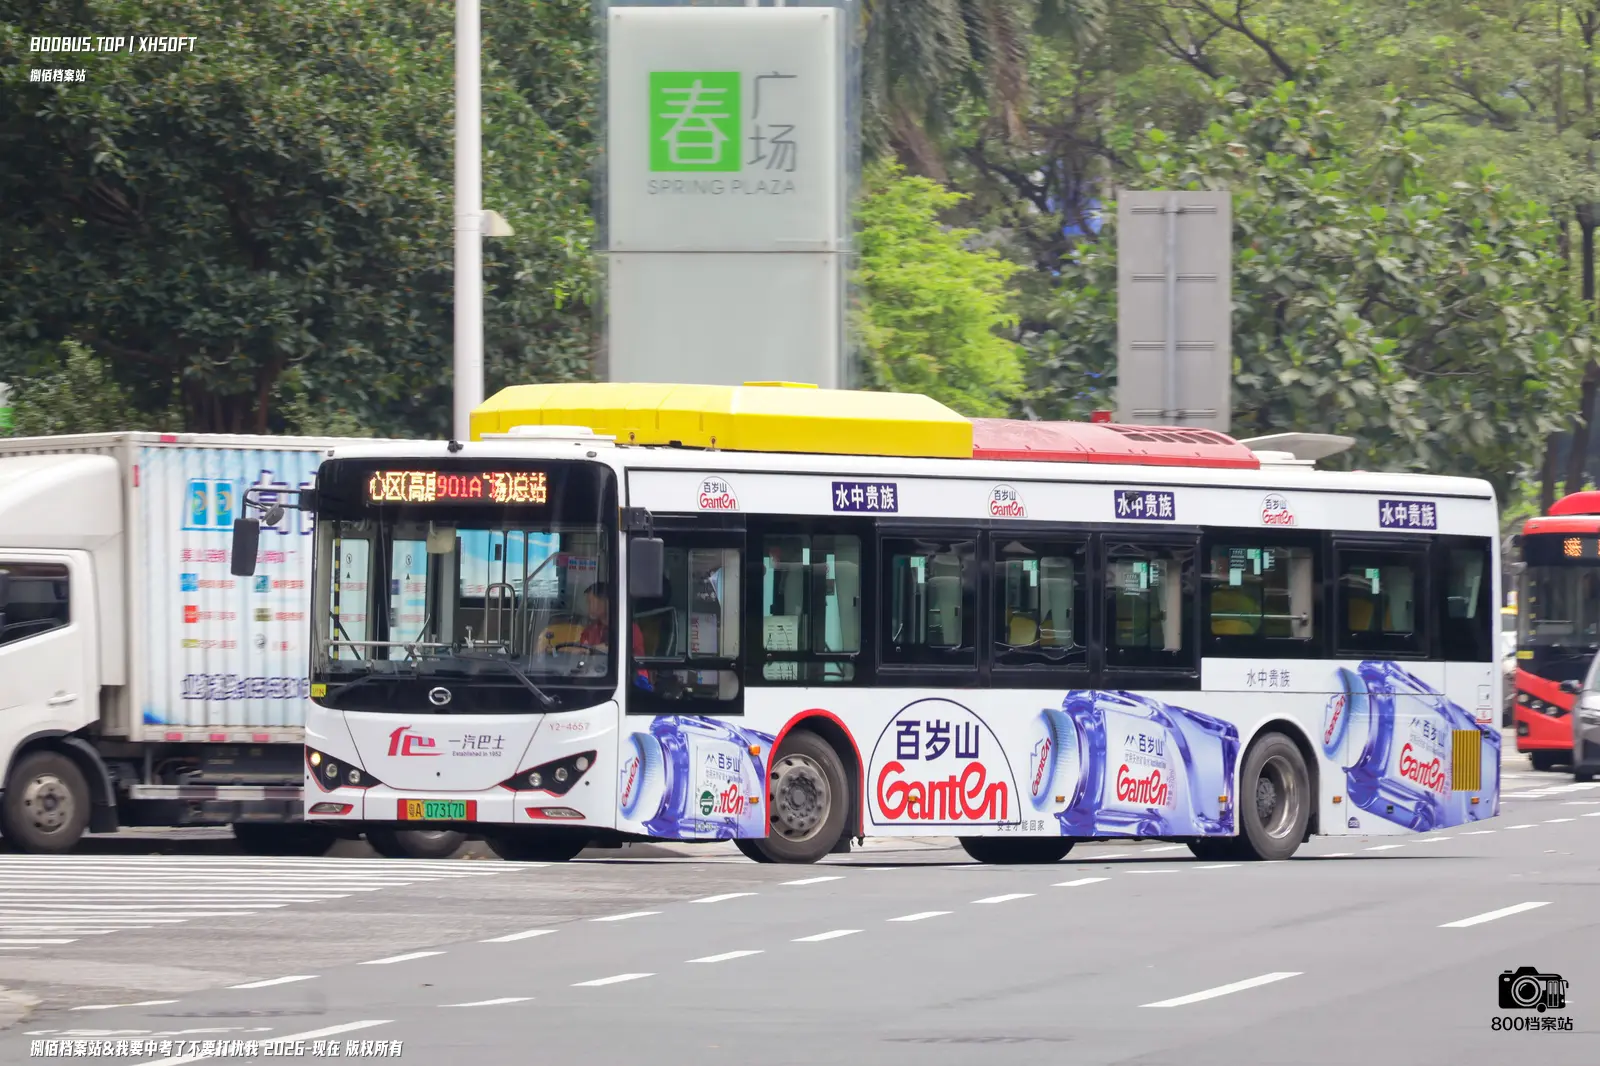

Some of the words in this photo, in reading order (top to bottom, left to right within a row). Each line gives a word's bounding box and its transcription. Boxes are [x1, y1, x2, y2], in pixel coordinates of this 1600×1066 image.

[659, 79, 731, 165] 春
[747, 71, 798, 172] 广场
[647, 179, 725, 195] SPRING
[730, 179, 796, 195] PLAZA
[437, 475, 482, 498] 901A
[703, 481, 727, 493] 百岁山
[835, 483, 895, 511] 水中贵族
[993, 489, 1016, 501] 百岁山
[700, 493, 736, 509] Ganten
[990, 500, 1025, 517] Ganten
[1117, 492, 1174, 518] 水中贵族
[1262, 509, 1295, 526] Ganten
[1380, 501, 1436, 527] 水中贵族
[1246, 668, 1291, 688] 水中贵族
[448, 734, 506, 750] 一汽巴士
[896, 719, 979, 761] 百岁山
[1139, 733, 1164, 757] 百岁山
[718, 752, 740, 773] 百岁山
[1399, 742, 1446, 794] Ganten
[877, 761, 1008, 820] Ganten
[1117, 763, 1168, 806] Ganten
